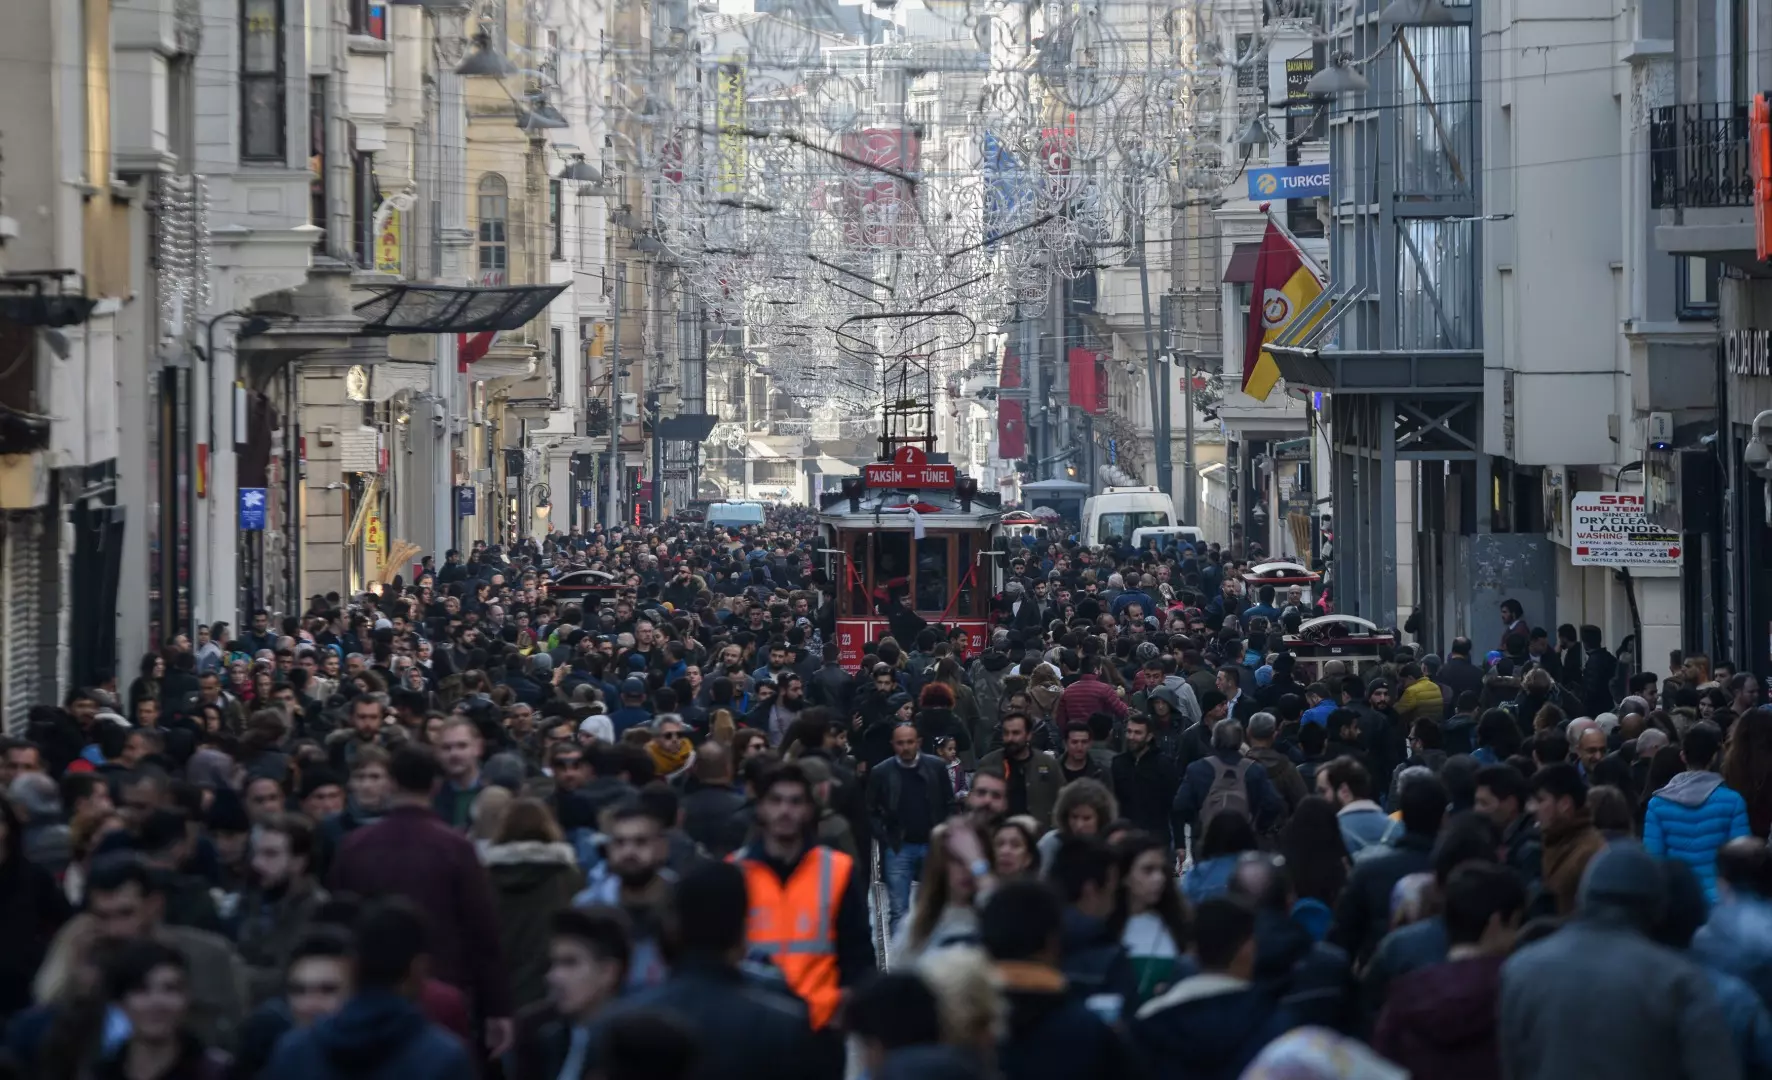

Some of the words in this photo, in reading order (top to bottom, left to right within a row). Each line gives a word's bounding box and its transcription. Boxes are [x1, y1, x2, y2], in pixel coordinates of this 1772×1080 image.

[906, 449, 913, 462] 2
[870, 468, 902, 482] TAKSİM
[920, 468, 950, 483] TÜNEL
[842, 634, 851, 646] 223
[972, 636, 981, 646] 223
